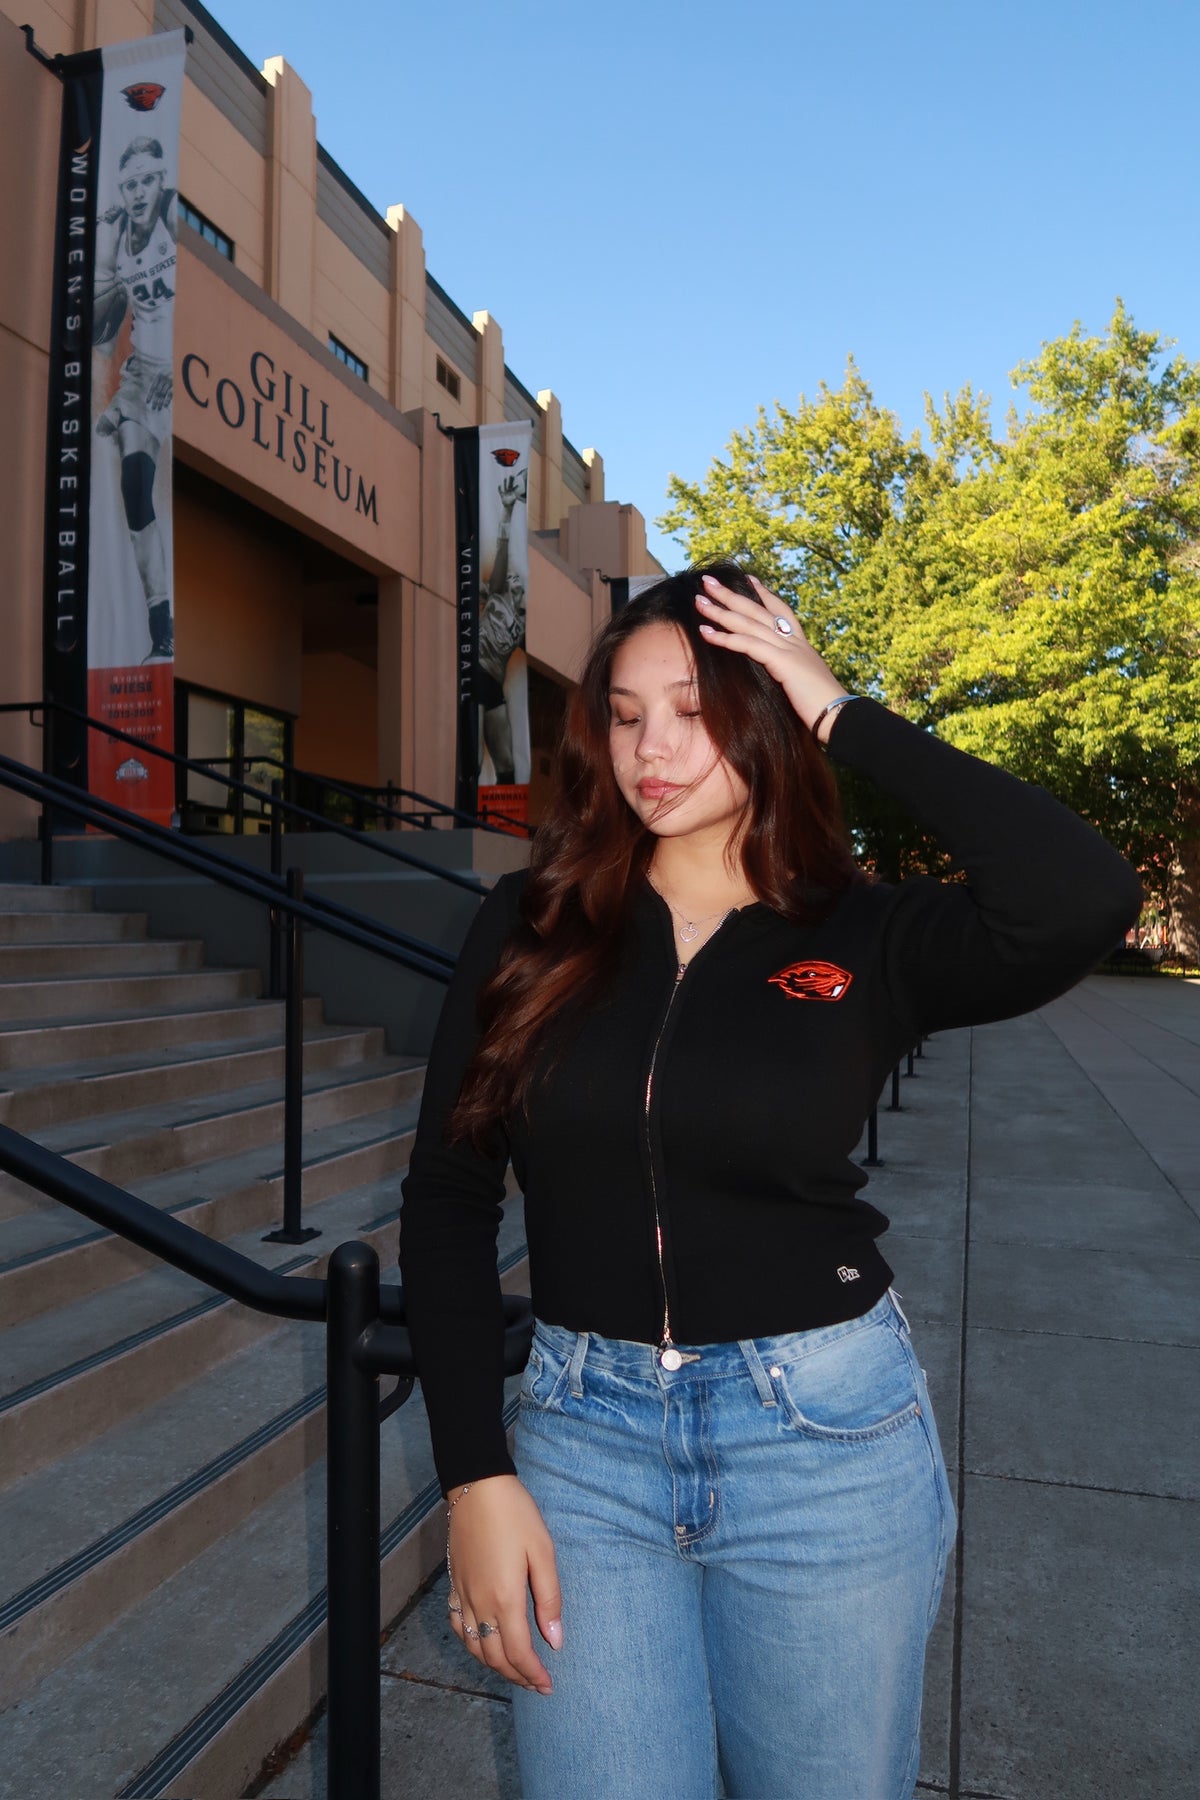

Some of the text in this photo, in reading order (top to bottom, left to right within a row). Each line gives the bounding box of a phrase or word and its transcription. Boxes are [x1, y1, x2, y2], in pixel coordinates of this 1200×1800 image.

[56, 153, 88, 631] WOMEN'S BASKETBALL
[182, 353, 380, 526] COLISEUM
[250, 351, 335, 448] GILL
[110, 682, 153, 694] WIESE
[460, 547, 473, 704] VOLLEYBALL
